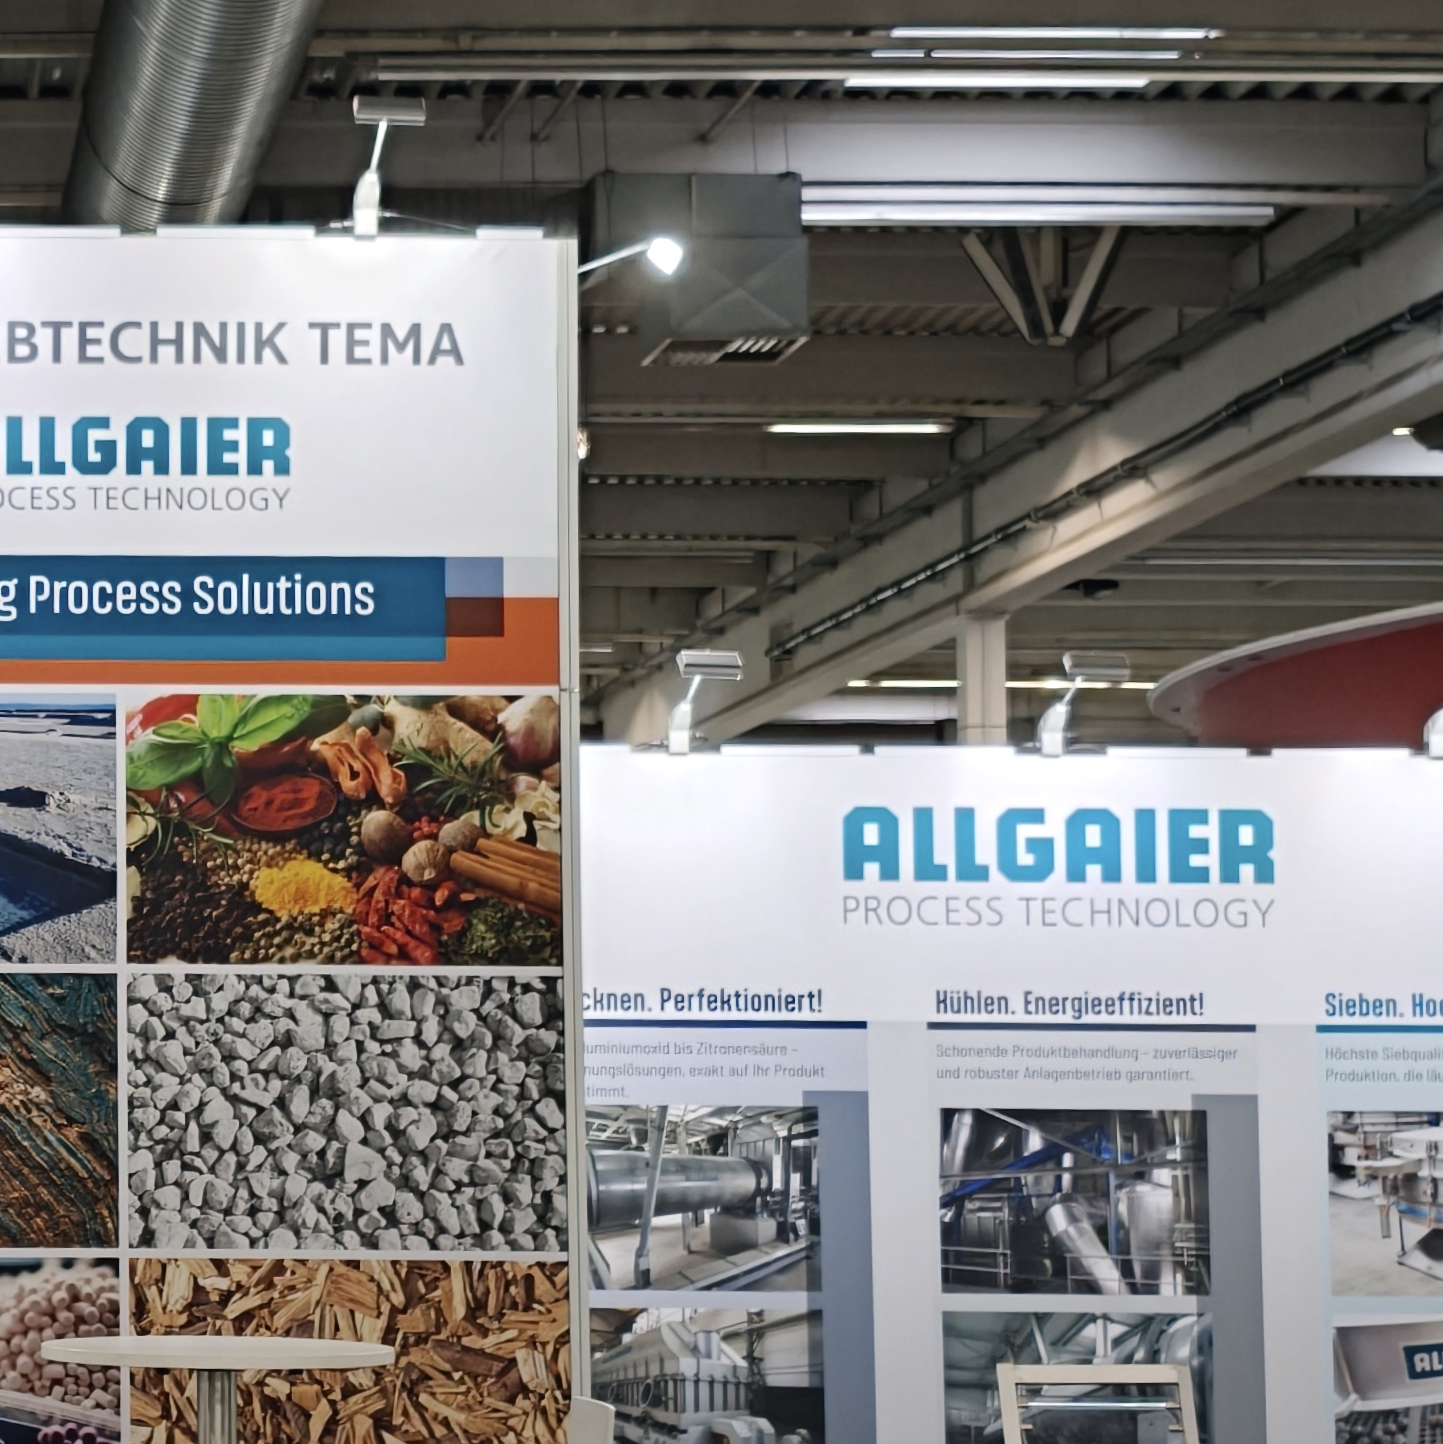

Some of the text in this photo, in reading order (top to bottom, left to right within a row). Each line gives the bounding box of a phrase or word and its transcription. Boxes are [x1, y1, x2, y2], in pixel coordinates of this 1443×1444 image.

[308, 321, 464, 366] TEMA
[91, 486, 291, 512] TECHNOLOGY
[28, 574, 182, 617] Process
[192, 574, 374, 617] Solutions
[843, 806, 1275, 885] ALLGAIER
[843, 895, 1276, 929] PROCESS TECHNOLOGY
[660, 988, 822, 1013] Perfektioniert!
[936, 990, 1205, 1019] Kühlen. Energieeffizient!
[1325, 993, 1404, 1018] Sieben.
[674, 1042, 693, 1055] bis
[696, 1041, 787, 1056] Zitronensäure
[936, 1044, 1008, 1058] Schonende
[1012, 1044, 1139, 1061] Produktbehandlung
[1152, 1046, 1238, 1062] zuverlässiger
[1325, 1046, 1378, 1061] Höchste
[689, 1064, 723, 1077] exakt
[728, 1064, 748, 1077] auf
[752, 1064, 770, 1077] Ihr
[774, 1064, 825, 1078] Produkt
[936, 1066, 1194, 1083] und robuster Anlagenbetrieb garantiert.
[1403, 1068, 1423, 1083] die
